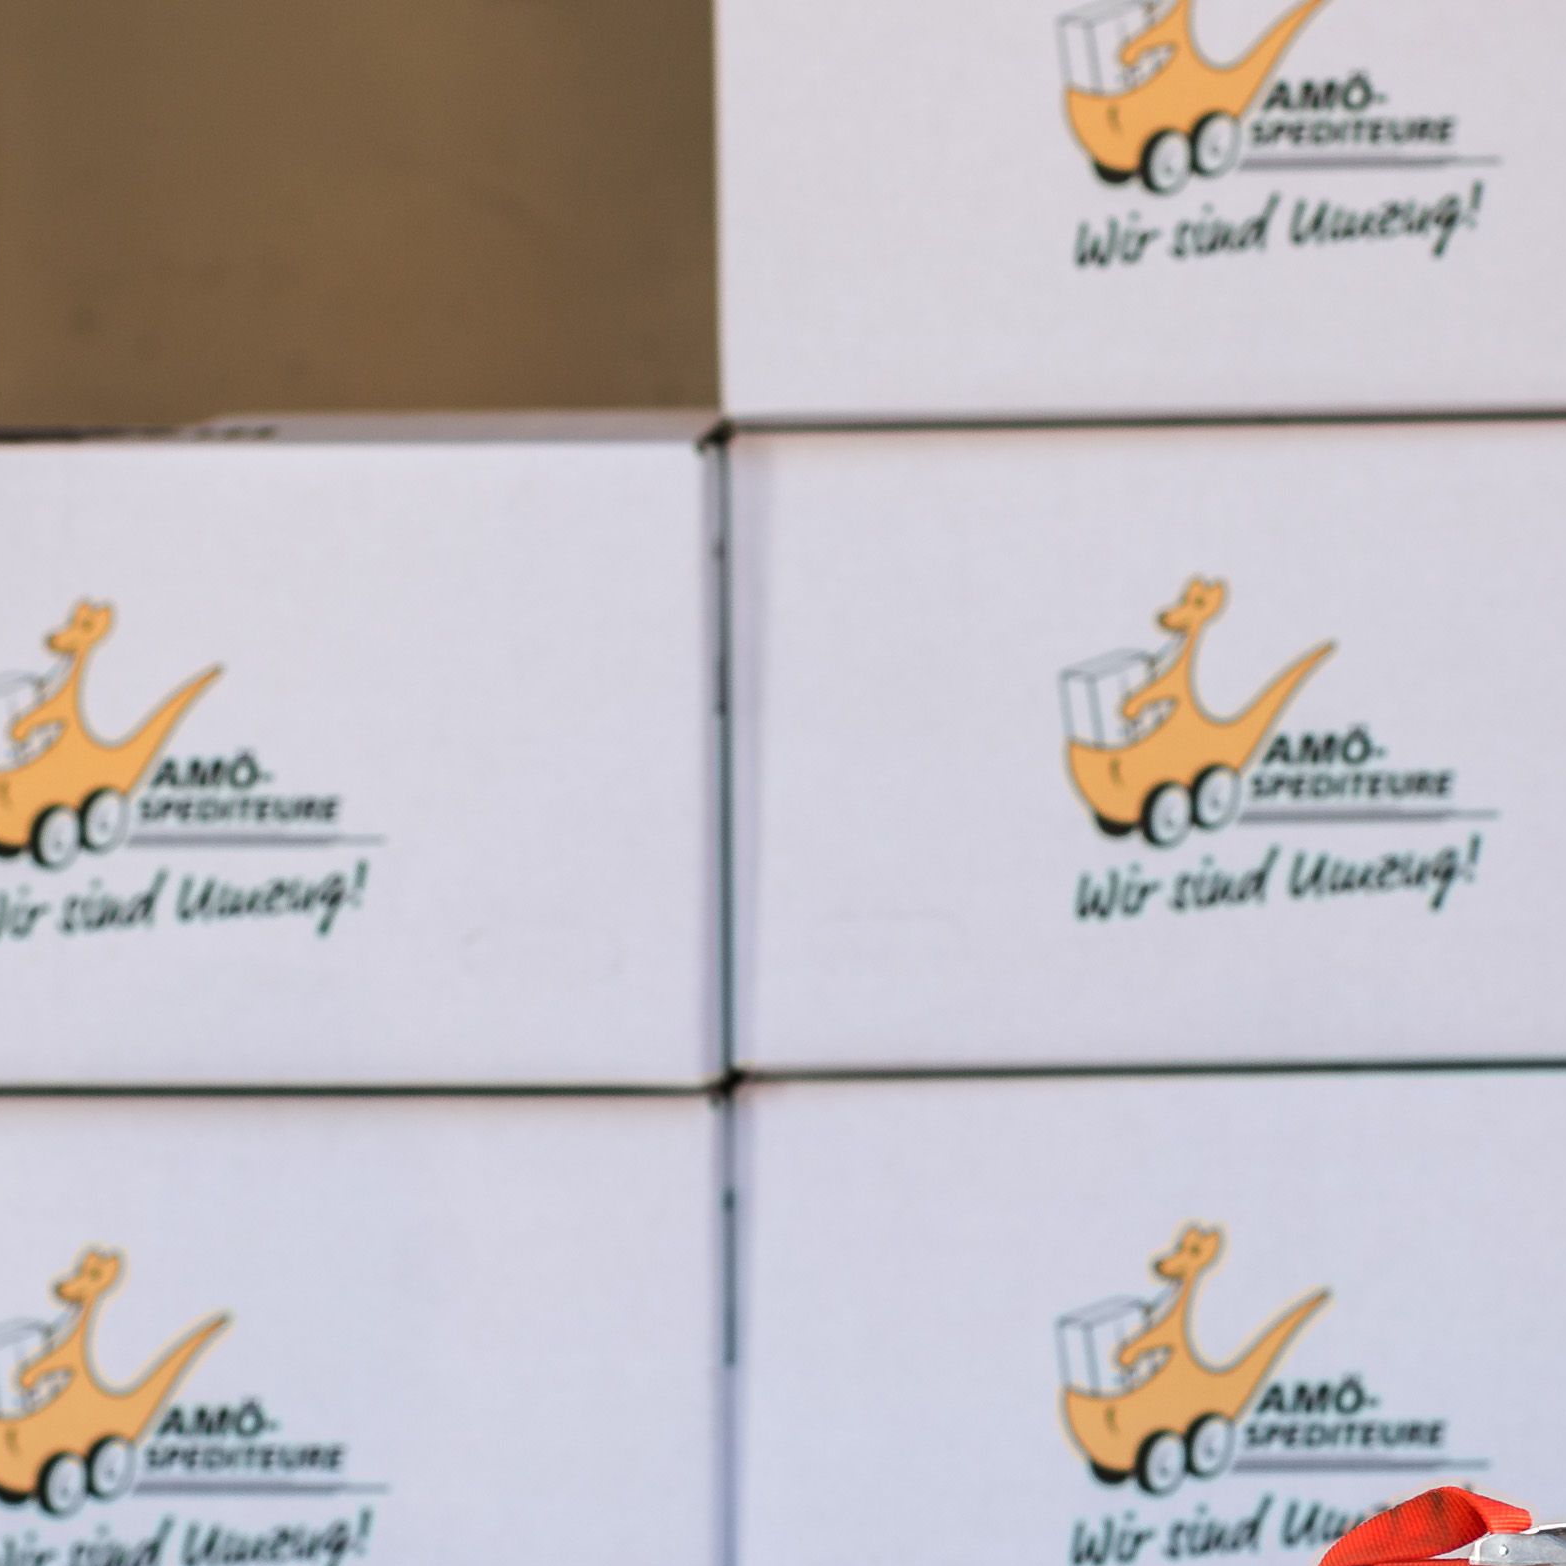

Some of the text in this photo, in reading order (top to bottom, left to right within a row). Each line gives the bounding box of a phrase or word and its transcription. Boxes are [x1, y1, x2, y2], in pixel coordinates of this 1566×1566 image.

[1263, 71, 1387, 111] AMÖ-
[1250, 116, 1454, 147] SPEDITEURE
[1074, 182, 1483, 268] Wir sind Umzug!
[1262, 725, 1386, 765] AMÖ-
[151, 750, 272, 789] AMÖ-
[1250, 771, 1453, 799] SPEDITEURE
[139, 796, 339, 823] SPEDITEURE
[1074, 834, 1481, 921] Wir sind Umzug!
[59, 868, 169, 933] sind
[177, 861, 368, 936] Umzug!
[1258, 1373, 1379, 1414] AMÖ-
[159, 1398, 280, 1437] AMÖ-
[1244, 1420, 1446, 1447] SPEDITEURE
[145, 1444, 343, 1472] SPEDITEURE
[1169, 1495, 1272, 1562] sind
